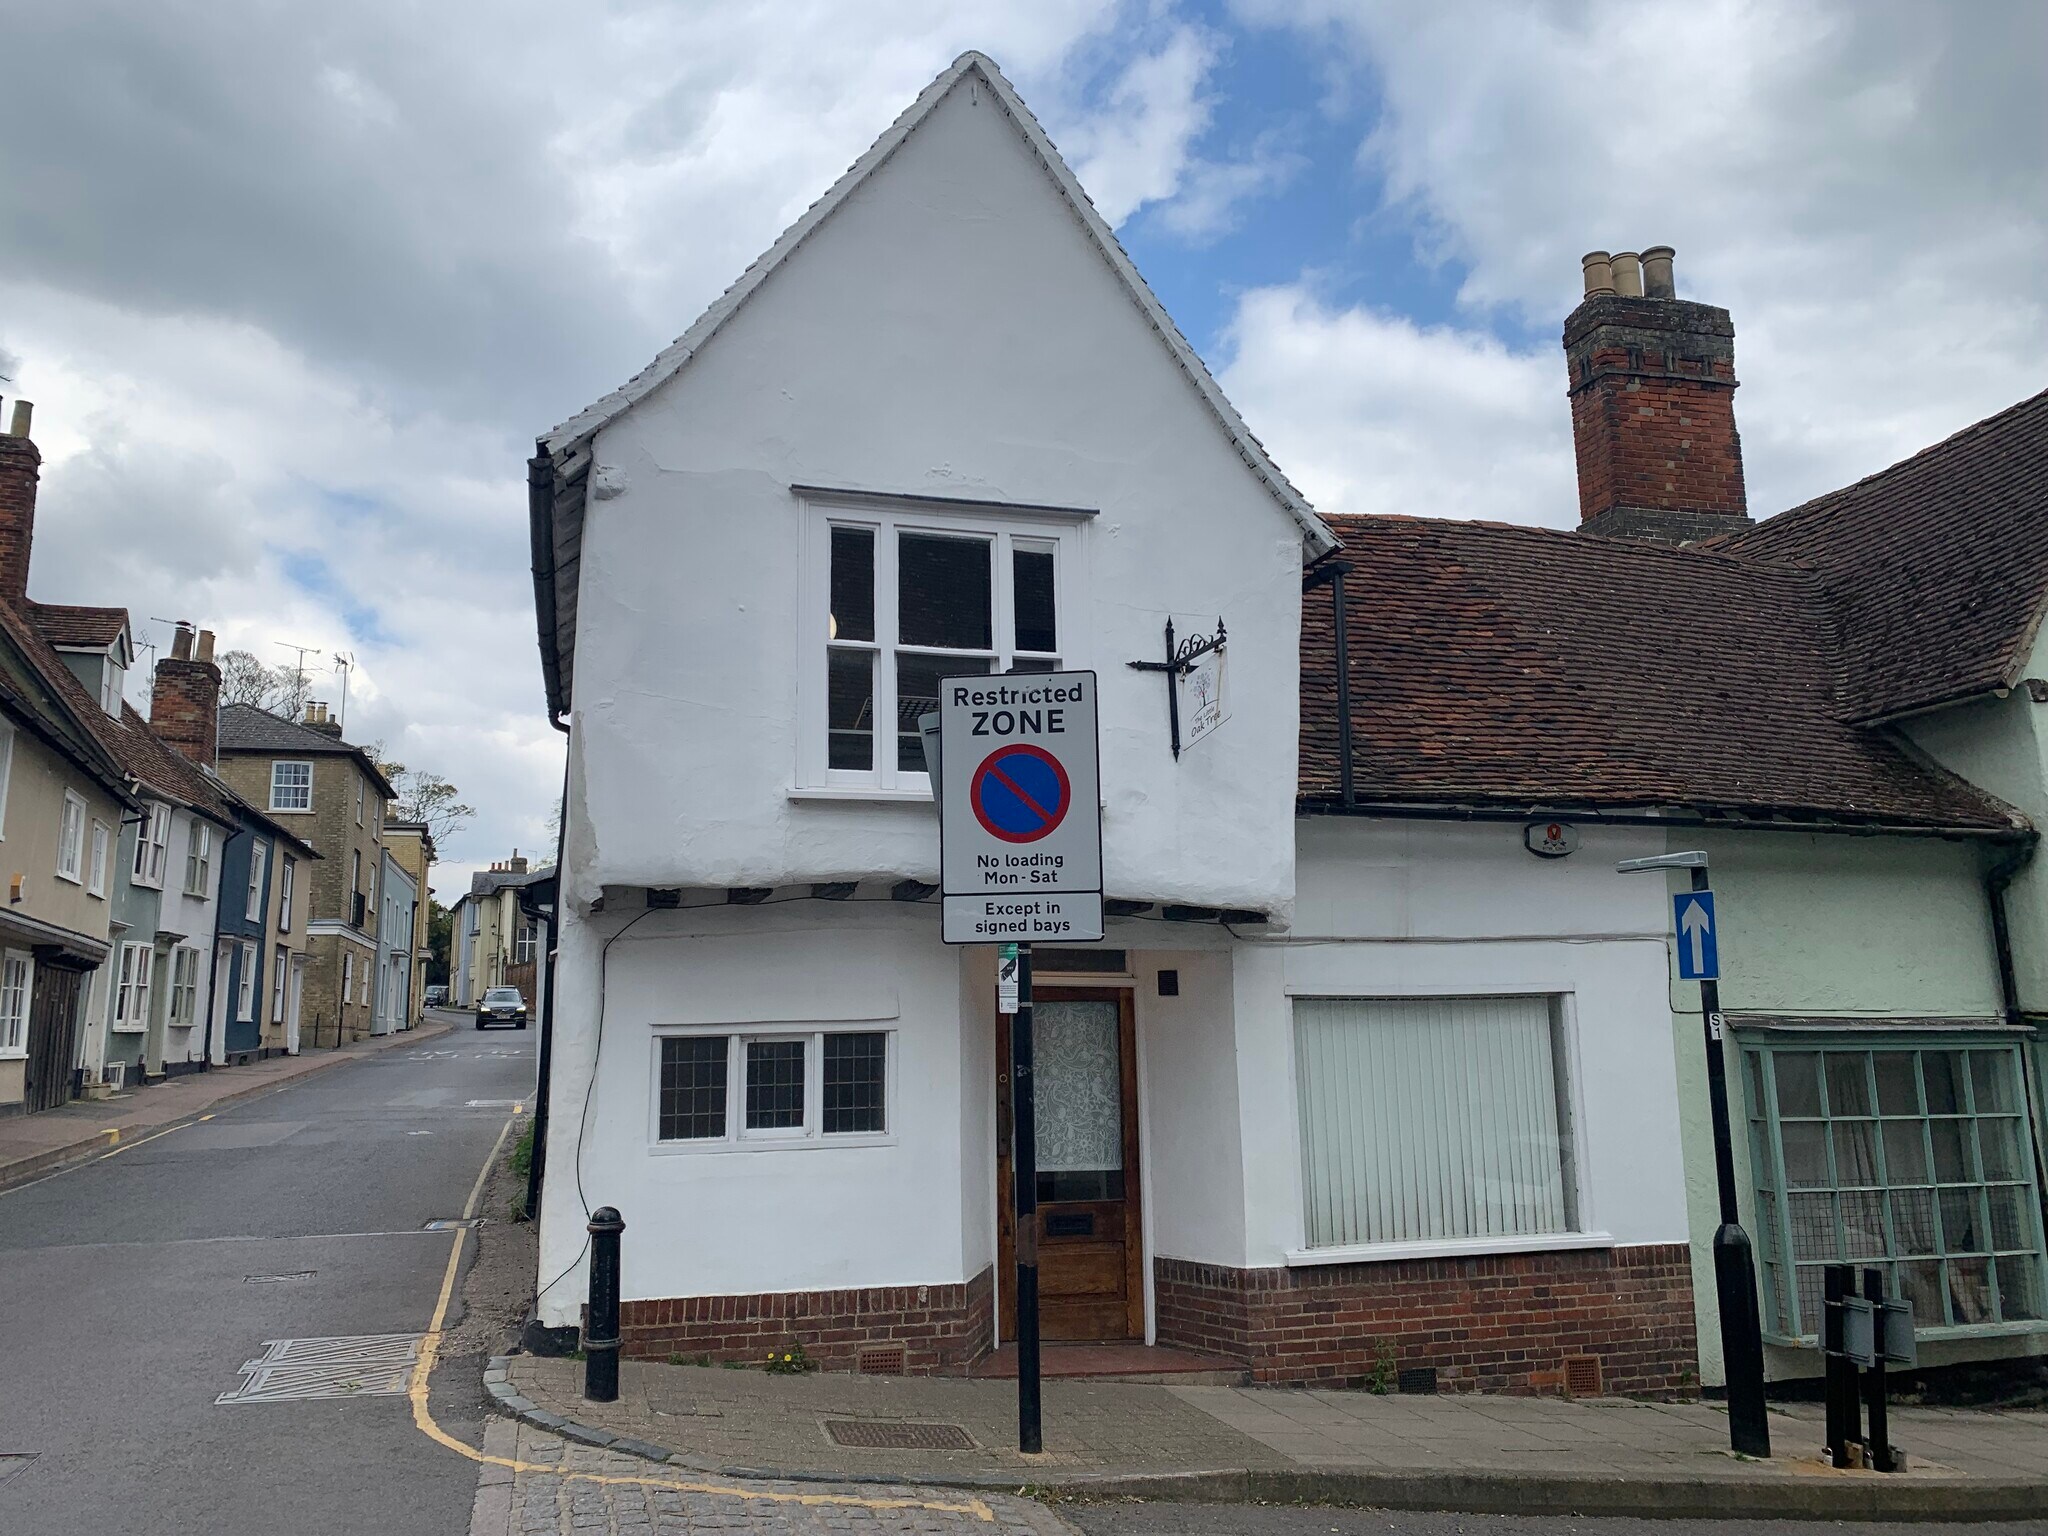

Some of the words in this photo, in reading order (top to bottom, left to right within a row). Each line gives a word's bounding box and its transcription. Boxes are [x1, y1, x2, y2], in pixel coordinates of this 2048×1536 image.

[954, 682, 1083, 707] Restricted
[971, 709, 1065, 736] ZONE
[1191, 721, 1205, 738] Oak
[1205, 710, 1221, 726] Tree
[977, 854, 1000, 868] No
[1005, 853, 1064, 868] loading
[985, 901, 1041, 917] Except
[1046, 901, 1060, 914] in
[975, 919, 1028, 935] signed
[1033, 919, 1071, 933] bays
